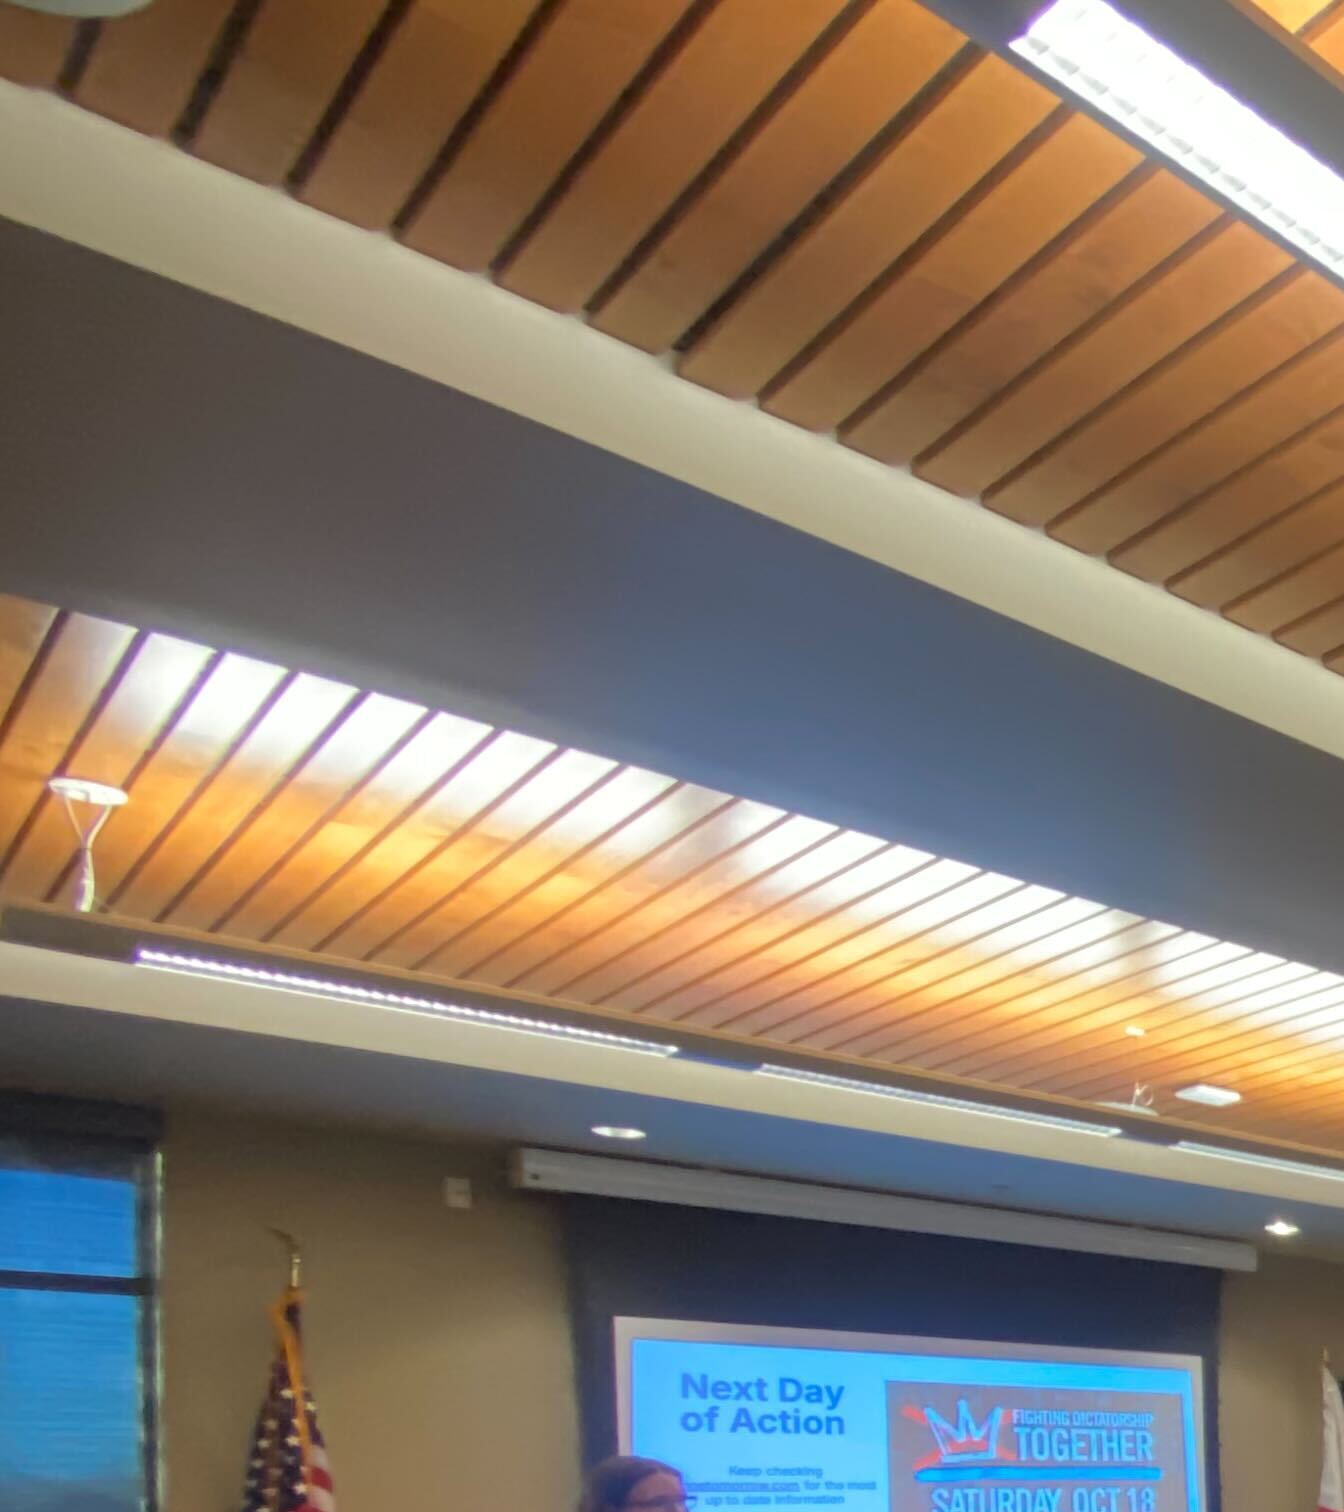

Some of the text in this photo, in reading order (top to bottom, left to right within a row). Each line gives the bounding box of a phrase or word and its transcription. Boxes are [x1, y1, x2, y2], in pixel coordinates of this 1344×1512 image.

[681, 1372, 845, 1411] Next Day
[680, 1405, 846, 1435] of Action
[1012, 1409, 1154, 1428] FIGHTING DICTATORSHIP
[1013, 1427, 1154, 1462] TOGETHER
